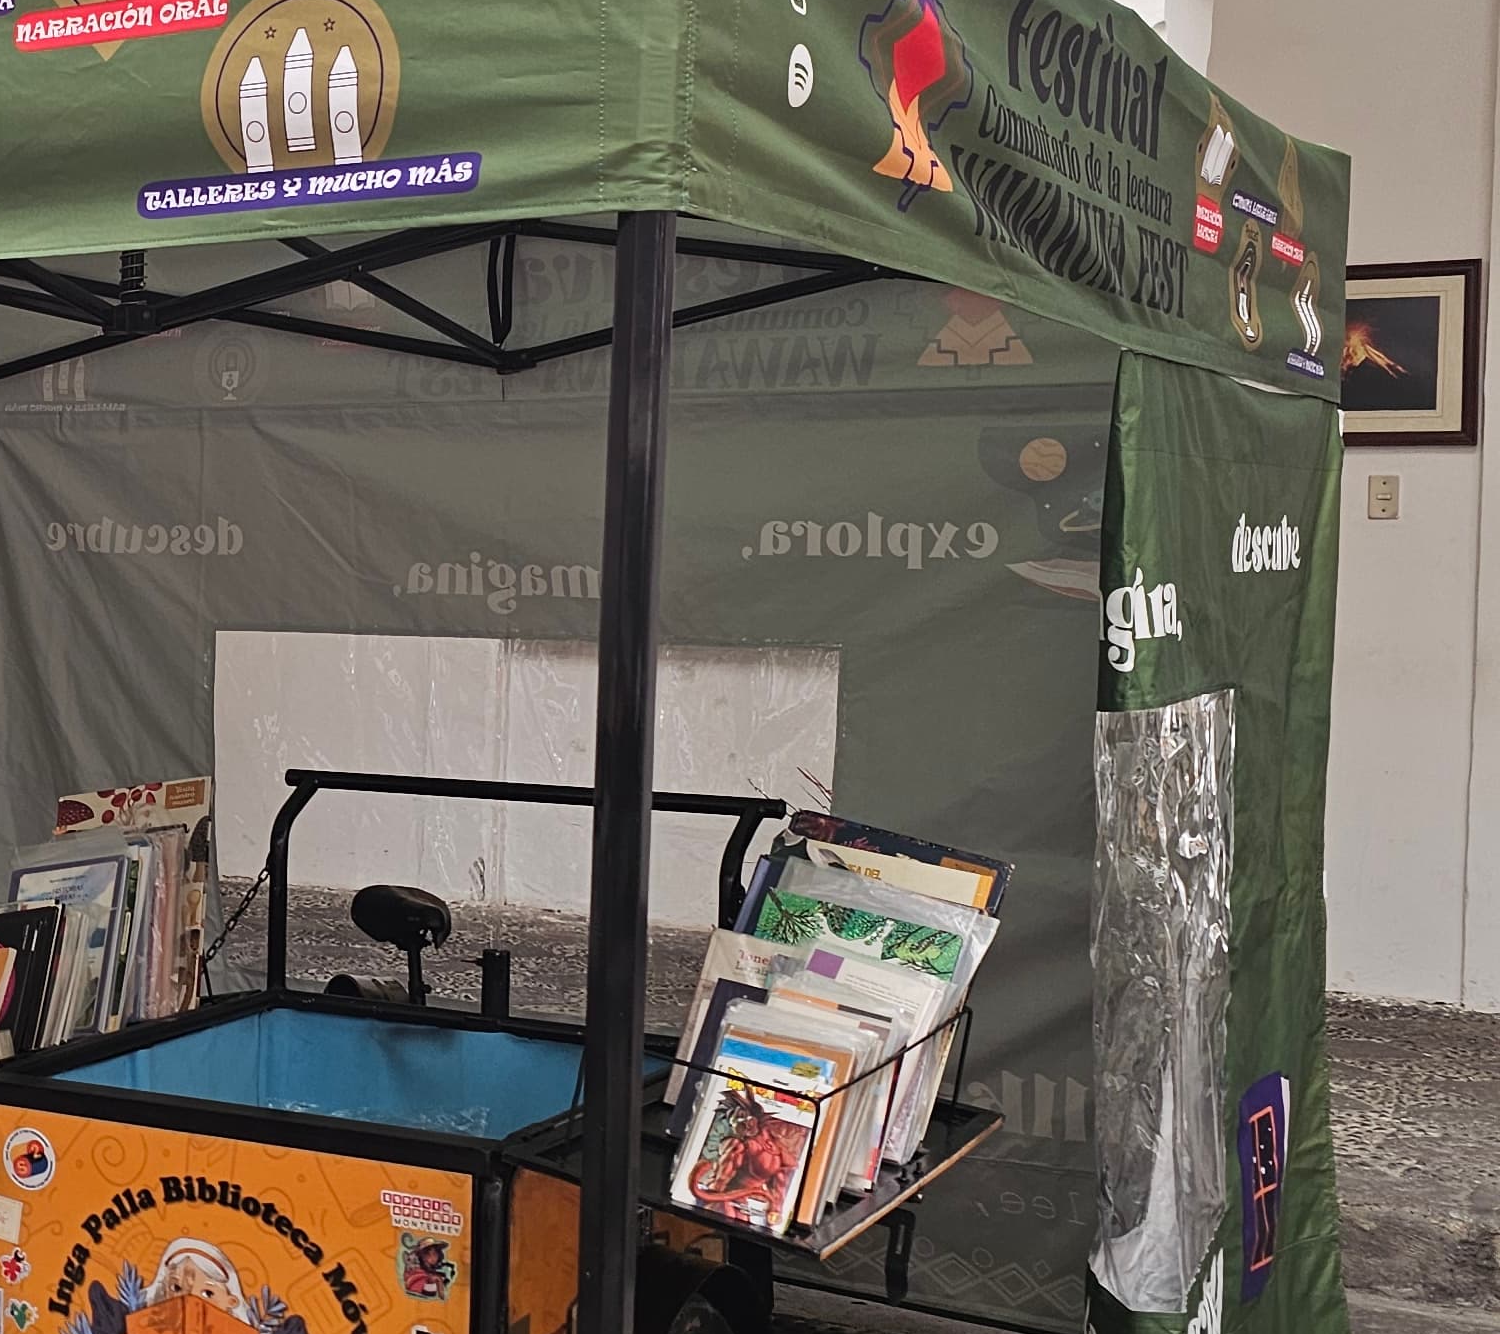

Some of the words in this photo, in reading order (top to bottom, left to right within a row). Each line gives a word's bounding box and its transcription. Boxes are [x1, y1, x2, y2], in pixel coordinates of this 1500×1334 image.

[16, 2, 153, 44] NARRACIÓN
[144, 179, 276, 211] TALLERES
[282, 177, 300, 197] Y
[307, 167, 401, 195] MUCHO
[407, 158, 473, 184] MÁS
[979, 83, 1081, 184] Comunitario
[1085, 142, 1103, 194] de
[1107, 150, 1121, 201] la
[1126, 159, 1173, 226] lectura
[1131, 224, 1188, 319] FEST
[48, 1243, 91, 1316] Inga
[81, 1188, 156, 1244] Palla
[159, 1175, 324, 1266] Biblioteca
[394, 1218, 460, 1233] MONTERREY
